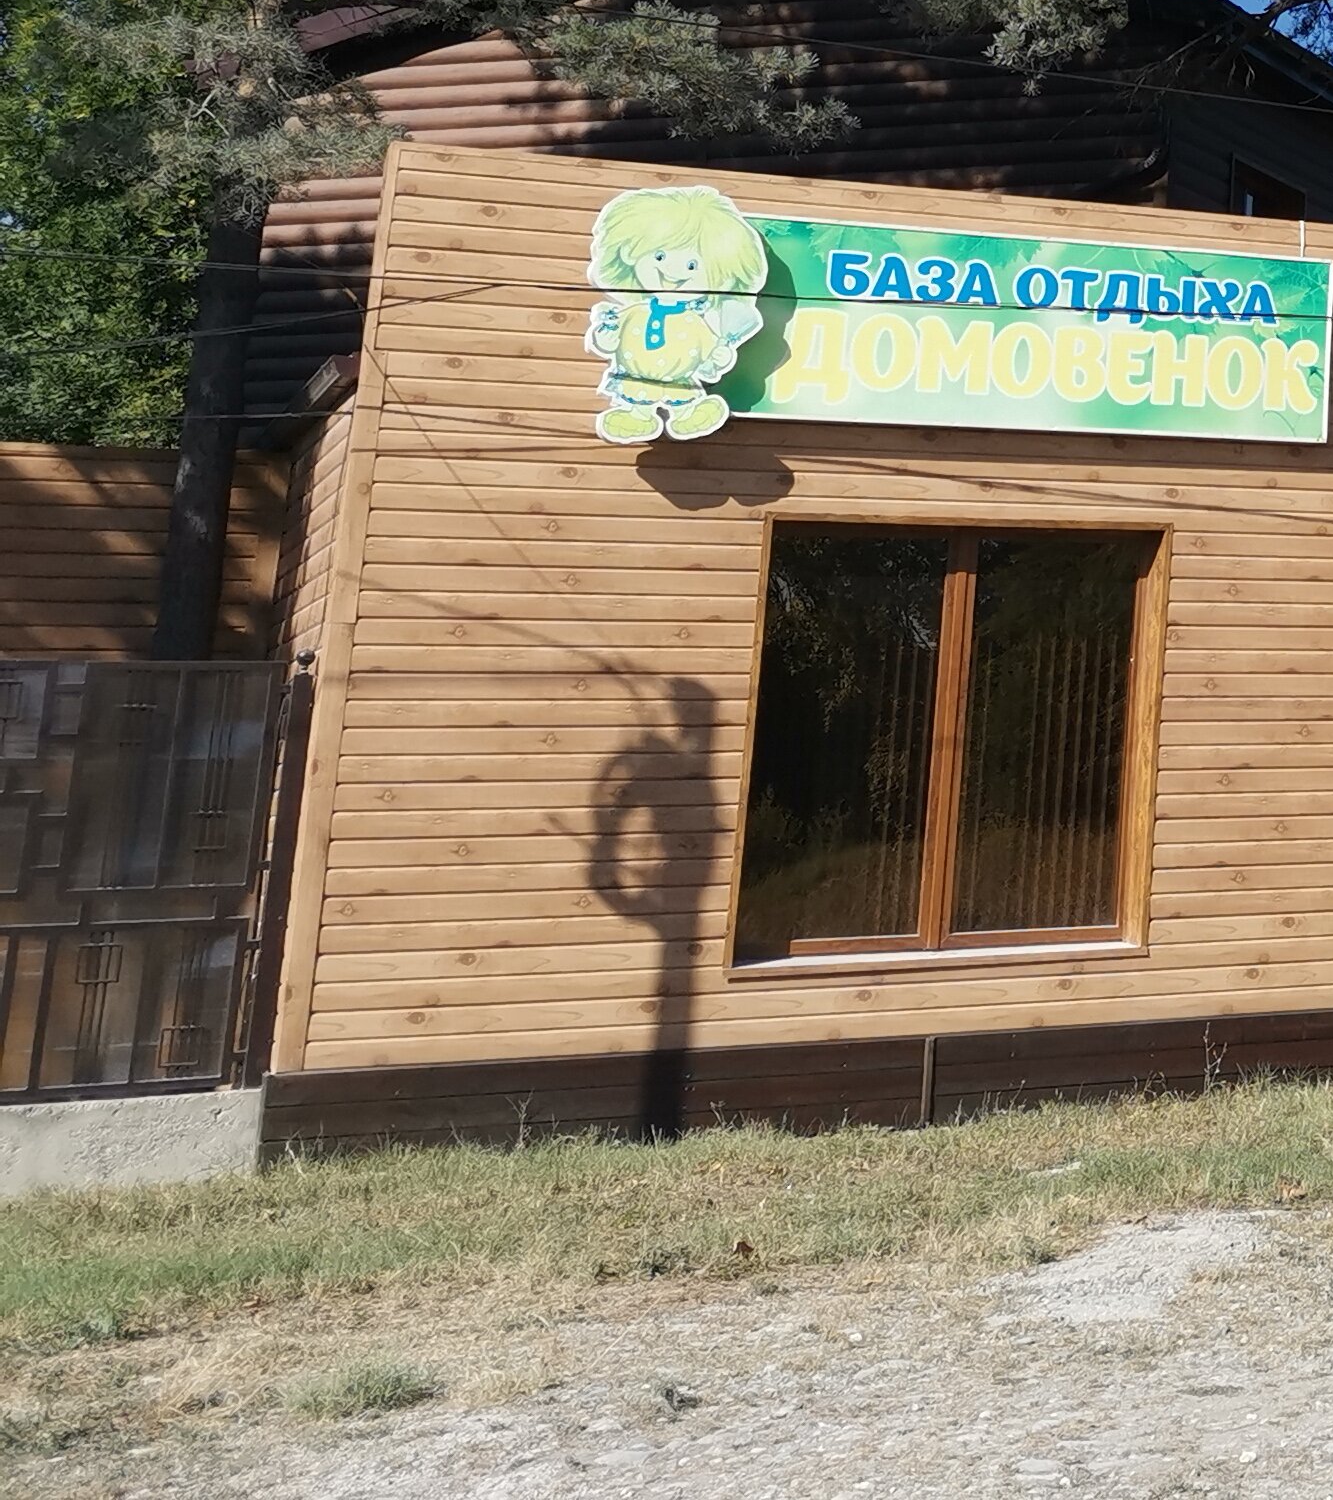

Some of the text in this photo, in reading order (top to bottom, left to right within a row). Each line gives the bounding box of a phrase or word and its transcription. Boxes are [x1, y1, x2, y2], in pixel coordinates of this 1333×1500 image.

[829, 252, 1278, 325] БАЗА ОТДЫХА
[771, 308, 1320, 414] ДОМОВЕНОК
